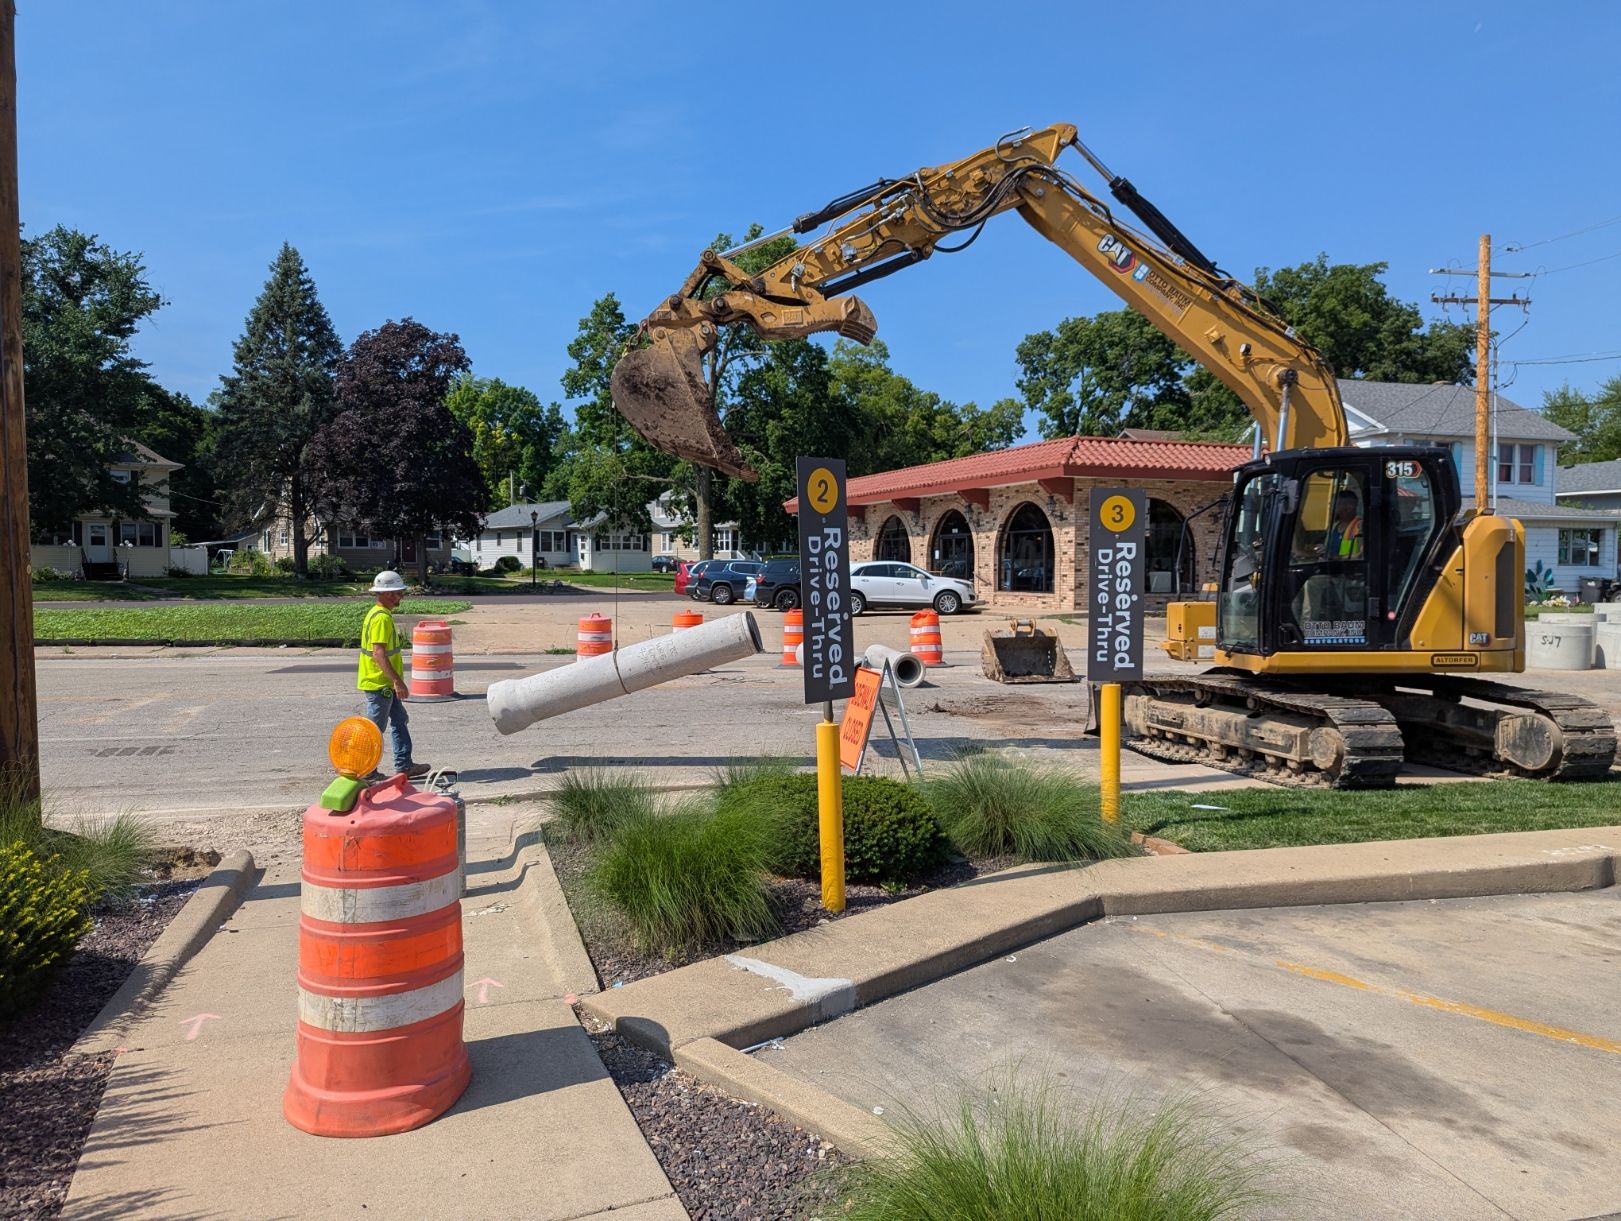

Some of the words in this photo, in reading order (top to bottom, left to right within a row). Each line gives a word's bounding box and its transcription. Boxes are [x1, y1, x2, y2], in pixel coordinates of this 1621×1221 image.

[1097, 234, 1132, 266] CAT
[1149, 270, 1168, 288] OTTO
[1387, 462, 1413, 476] 315
[817, 479, 829, 503] 2
[1111, 504, 1124, 523] 3
[808, 536, 825, 679] Drive-Thru
[823, 527, 848, 686] Reserved
[1096, 549, 1113, 662] Drive-Thru
[1114, 542, 1137, 669] Reserved
[1304, 620, 1331, 630] OTTO
[1333, 620, 1365, 630] BAUM
[1469, 632, 1488, 645] CAT
